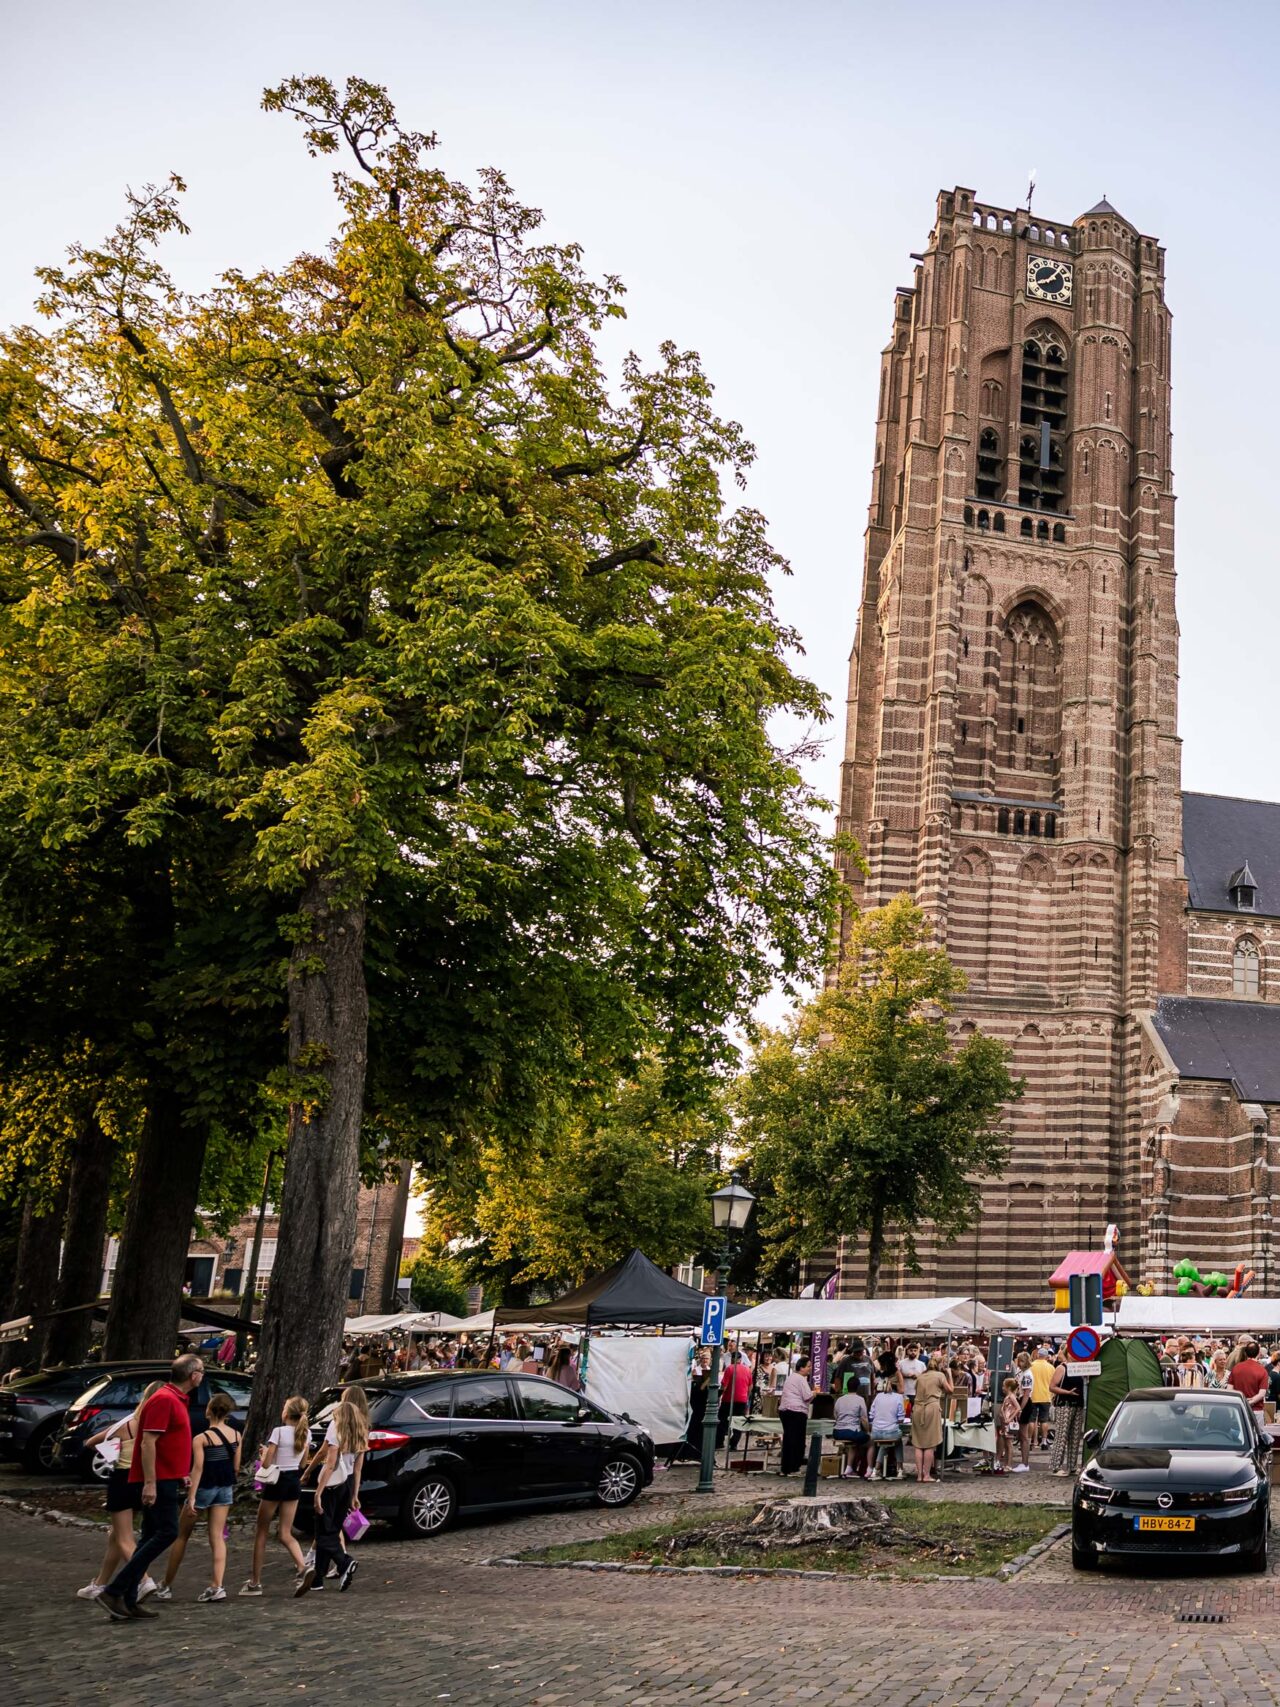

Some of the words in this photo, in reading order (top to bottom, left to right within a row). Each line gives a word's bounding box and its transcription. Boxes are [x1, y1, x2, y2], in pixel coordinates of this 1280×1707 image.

[707, 1301, 720, 1324] P
[813, 1331, 822, 1353] Oirs
[814, 1356, 822, 1373] van
[1142, 1519, 1191, 1529] HBV-84-Z
